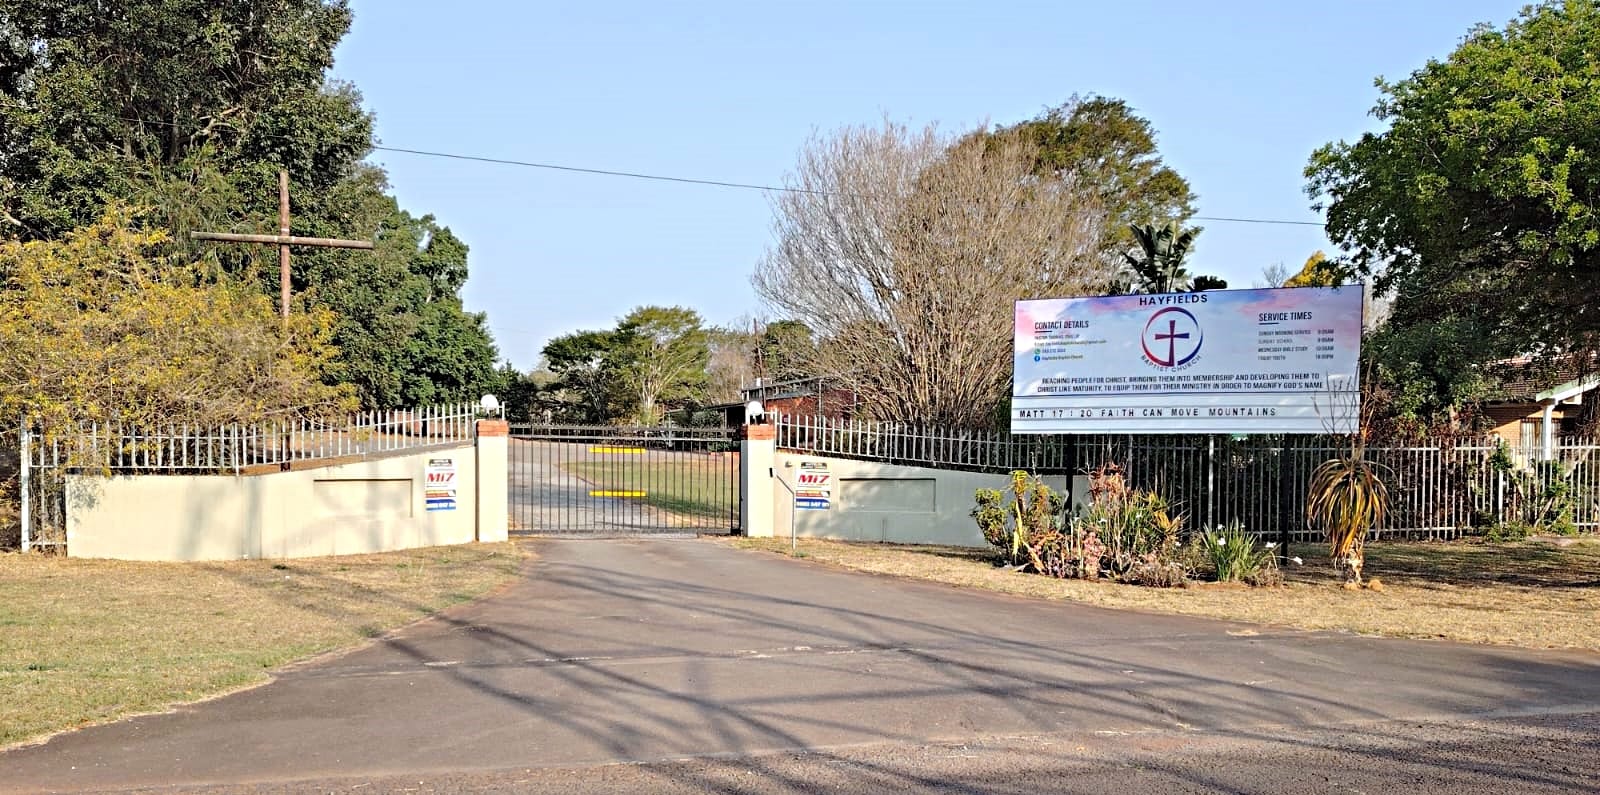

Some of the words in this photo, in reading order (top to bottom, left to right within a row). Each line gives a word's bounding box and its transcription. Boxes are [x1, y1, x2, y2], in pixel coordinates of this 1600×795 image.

[1140, 294, 1208, 306] HAYFIELDS
[1258, 312, 1288, 322] SERVICE
[1290, 311, 1312, 320] TIMES
[1034, 321, 1062, 330] CONTACT
[1064, 320, 1089, 329] DETAILS
[1141, 354, 1168, 372] BAPTIST
[1171, 355, 1202, 372] CHURCH
